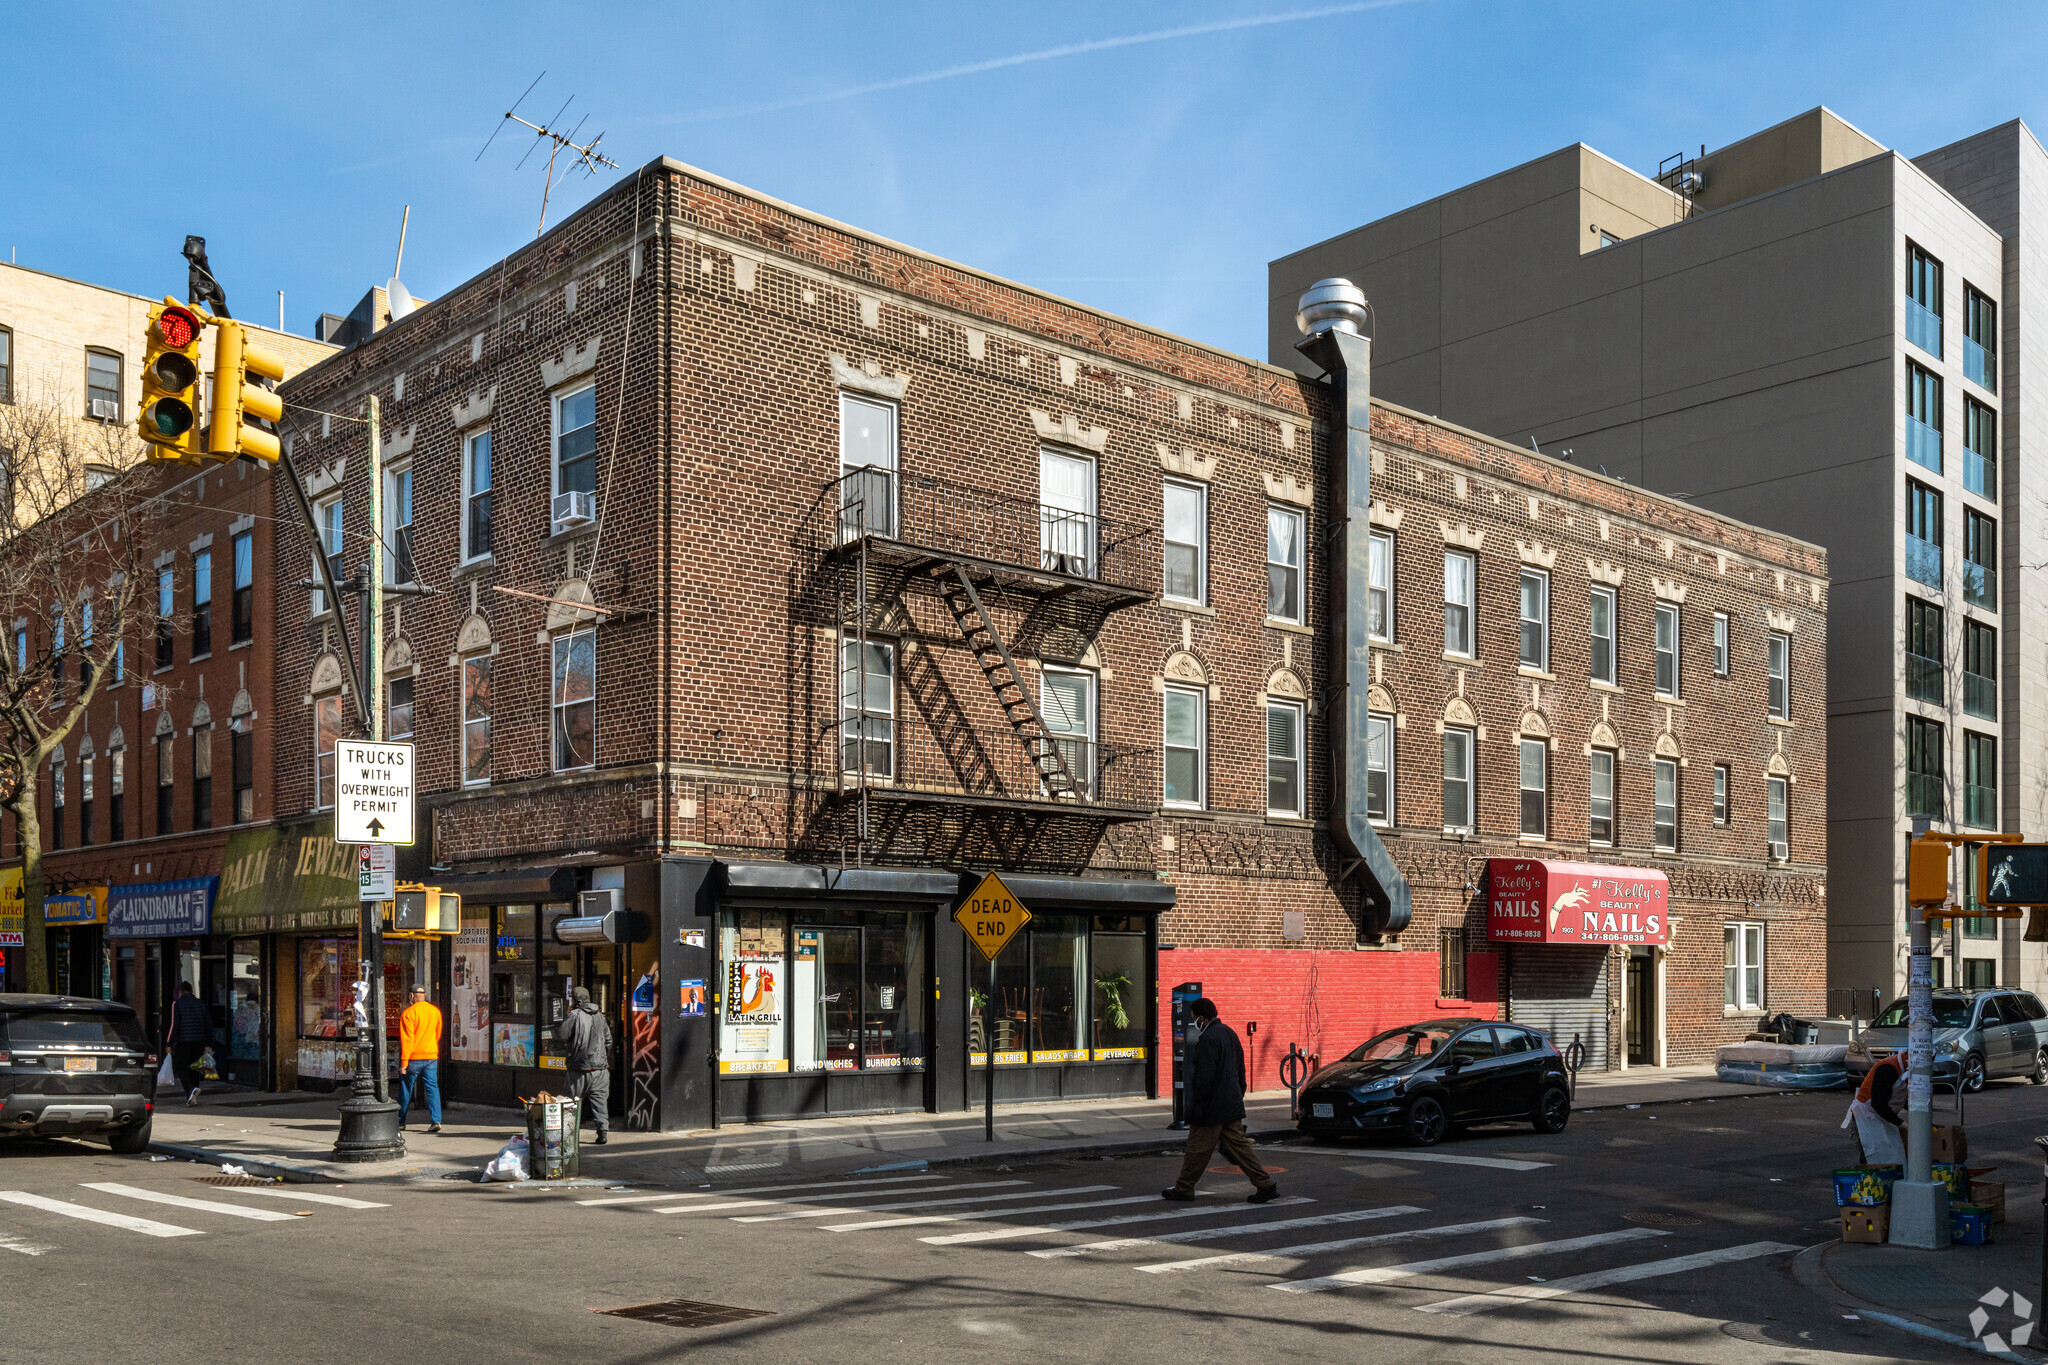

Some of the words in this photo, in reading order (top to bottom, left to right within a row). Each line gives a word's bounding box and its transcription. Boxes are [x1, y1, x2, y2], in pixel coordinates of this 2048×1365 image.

[347, 750, 404, 765] TRUCKS
[361, 769, 391, 780] WITH
[341, 784, 409, 797] OVERWEIGHT
[353, 801, 397, 812] PERMIT
[218, 847, 271, 900] PALM
[294, 836, 359, 883] JEWELR
[361, 875, 370, 884] 15
[1494, 876, 1541, 891] Kelly's
[5, 887, 16, 900] Fis
[1592, 878, 1601, 889] #1
[1604, 880, 1661, 903] Kelly's
[123, 893, 191, 921] LAUNDROMAT
[972, 899, 1012, 913] DEAD
[1494, 900, 1540, 918] NAILS
[1600, 901, 1640, 910] BEAUTY
[238, 917, 243, 930] &
[301, 910, 329, 927] WATCHES
[332, 909, 337, 925] &
[341, 908, 358, 925] SILVE
[1583, 911, 1661, 935] NAILS
[461, 928, 473, 936] PORT
[476, 928, 489, 936] BEER
[977, 922, 1006, 936] END
[472, 936, 488, 944] HERE!
[1581, 933, 1645, 942] 347-806-0838
[734, 962, 742, 1012] FLATBUSH
[729, 1013, 755, 1022] LATIN
[758, 1013, 782, 1022] GRILL
[1103, 1050, 1139, 1058] BEVERAGES
[548, 1058, 556, 1067] WE
[730, 1062, 777, 1072] BREAKFAST
[801, 1059, 853, 1070] SANDWICHES
